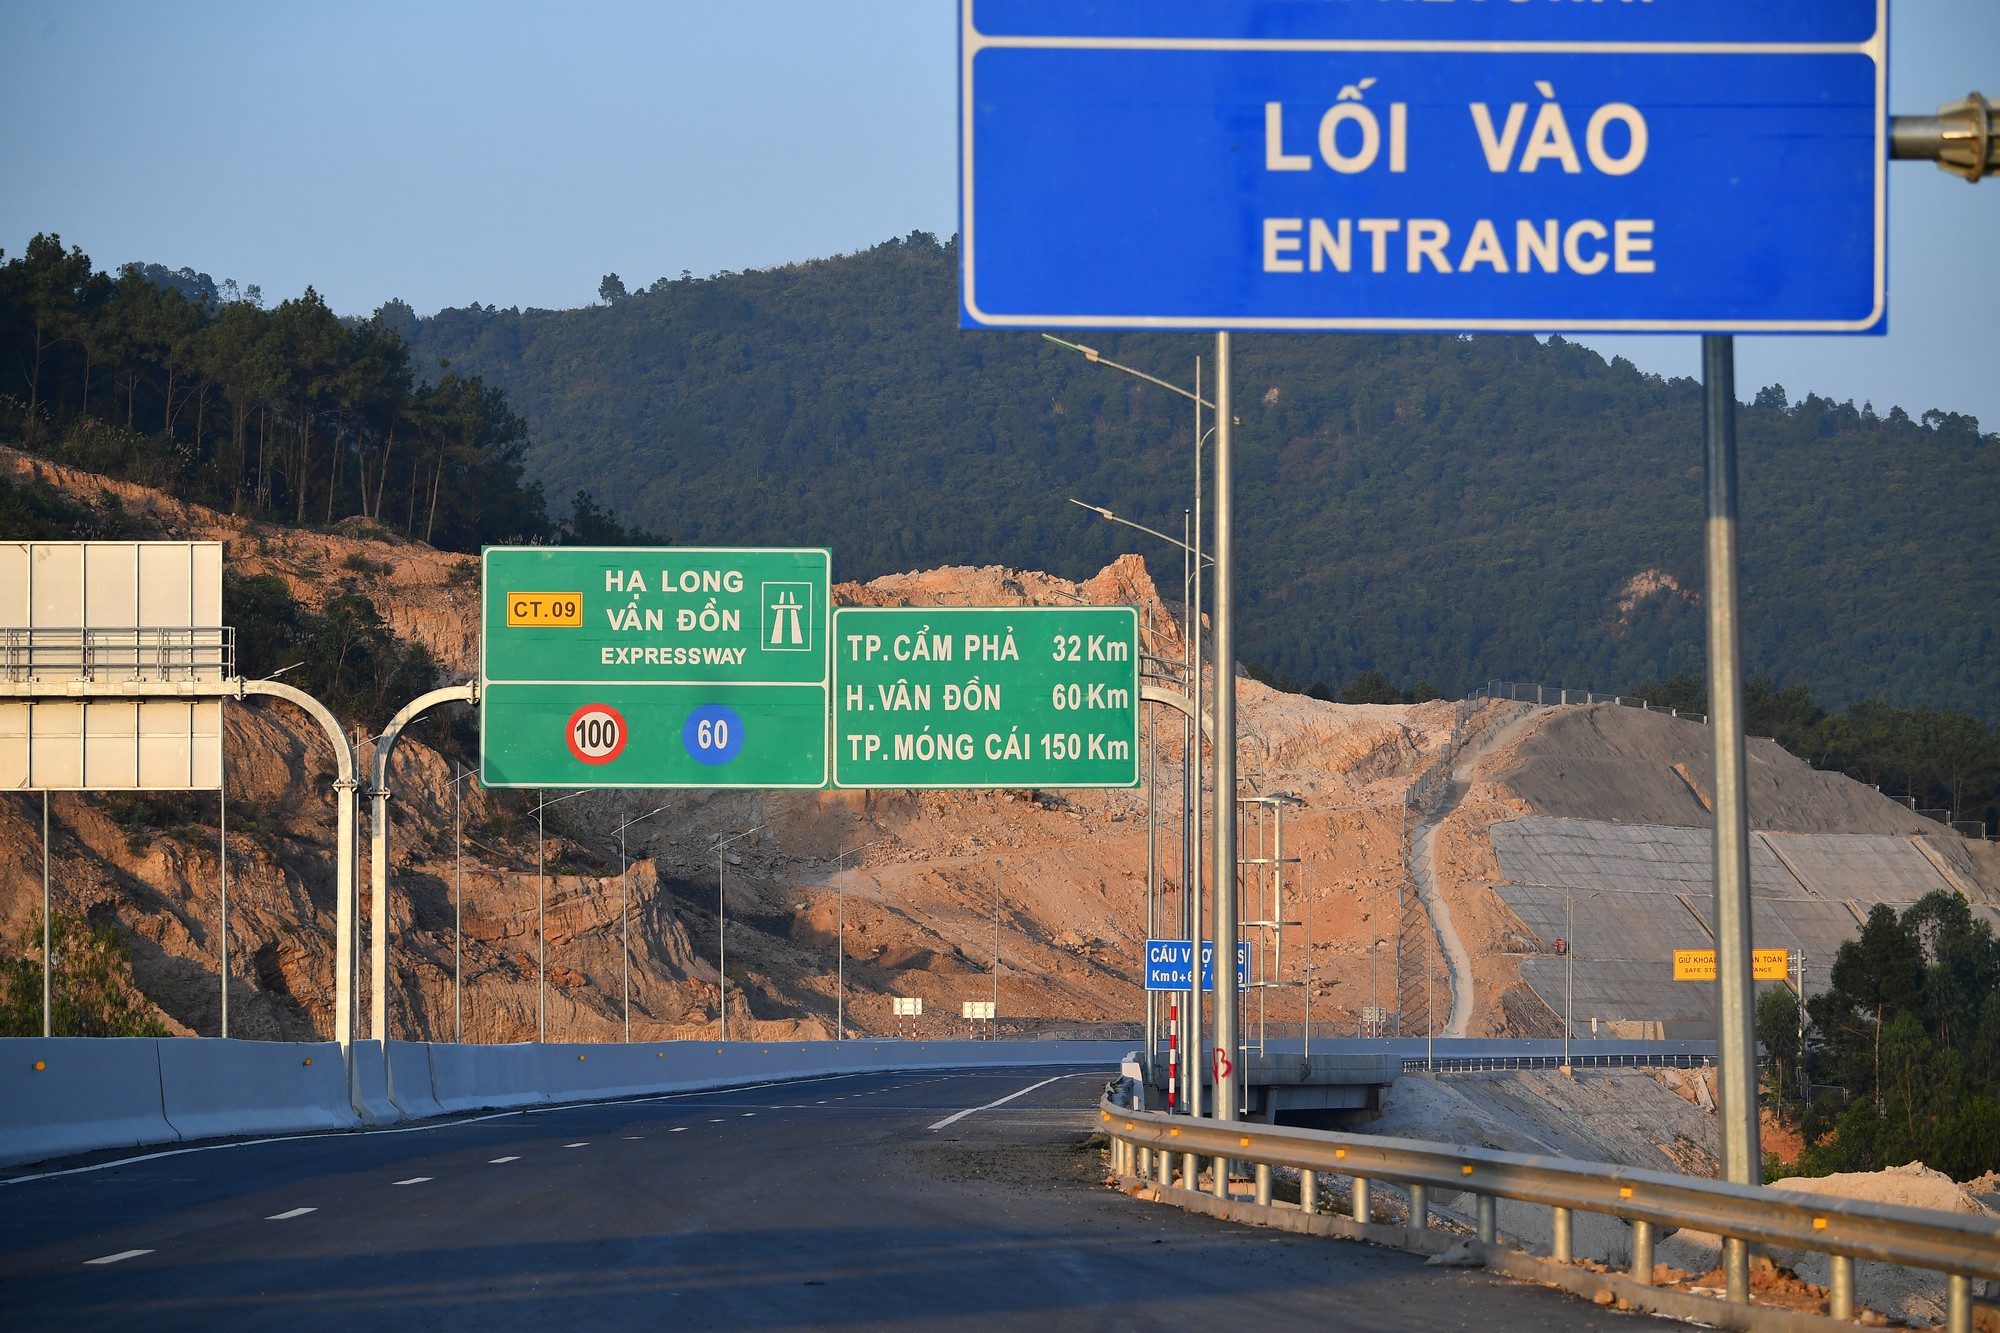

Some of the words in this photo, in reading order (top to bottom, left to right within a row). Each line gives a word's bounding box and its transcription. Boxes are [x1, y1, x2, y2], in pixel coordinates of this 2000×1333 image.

[1265, 78, 1407, 174] LỐI
[1469, 81, 1649, 176] VÀO
[1263, 218, 1656, 275] ENTRANCE
[605, 570, 648, 600] HẠ
[661, 570, 744, 593] LONG
[513, 601, 576, 618] CT.09
[606, 601, 664, 631] VÂN
[676, 597, 741, 631] ĐỒN
[601, 647, 747, 665] EXPRESSWAY
[964, 625, 1020, 661] PHẢ
[1052, 635, 1081, 661] 32
[1087, 634, 1128, 661] Km
[943, 675, 1001, 711] ĐỒN
[1052, 683, 1081, 710] 60
[1087, 683, 1129, 709] Km
[575, 719, 616, 749] 100
[697, 719, 728, 750] 60
[984, 725, 1031, 761] CÁI
[1040, 733, 1081, 760] 150
[1088, 733, 1129, 760] Km
